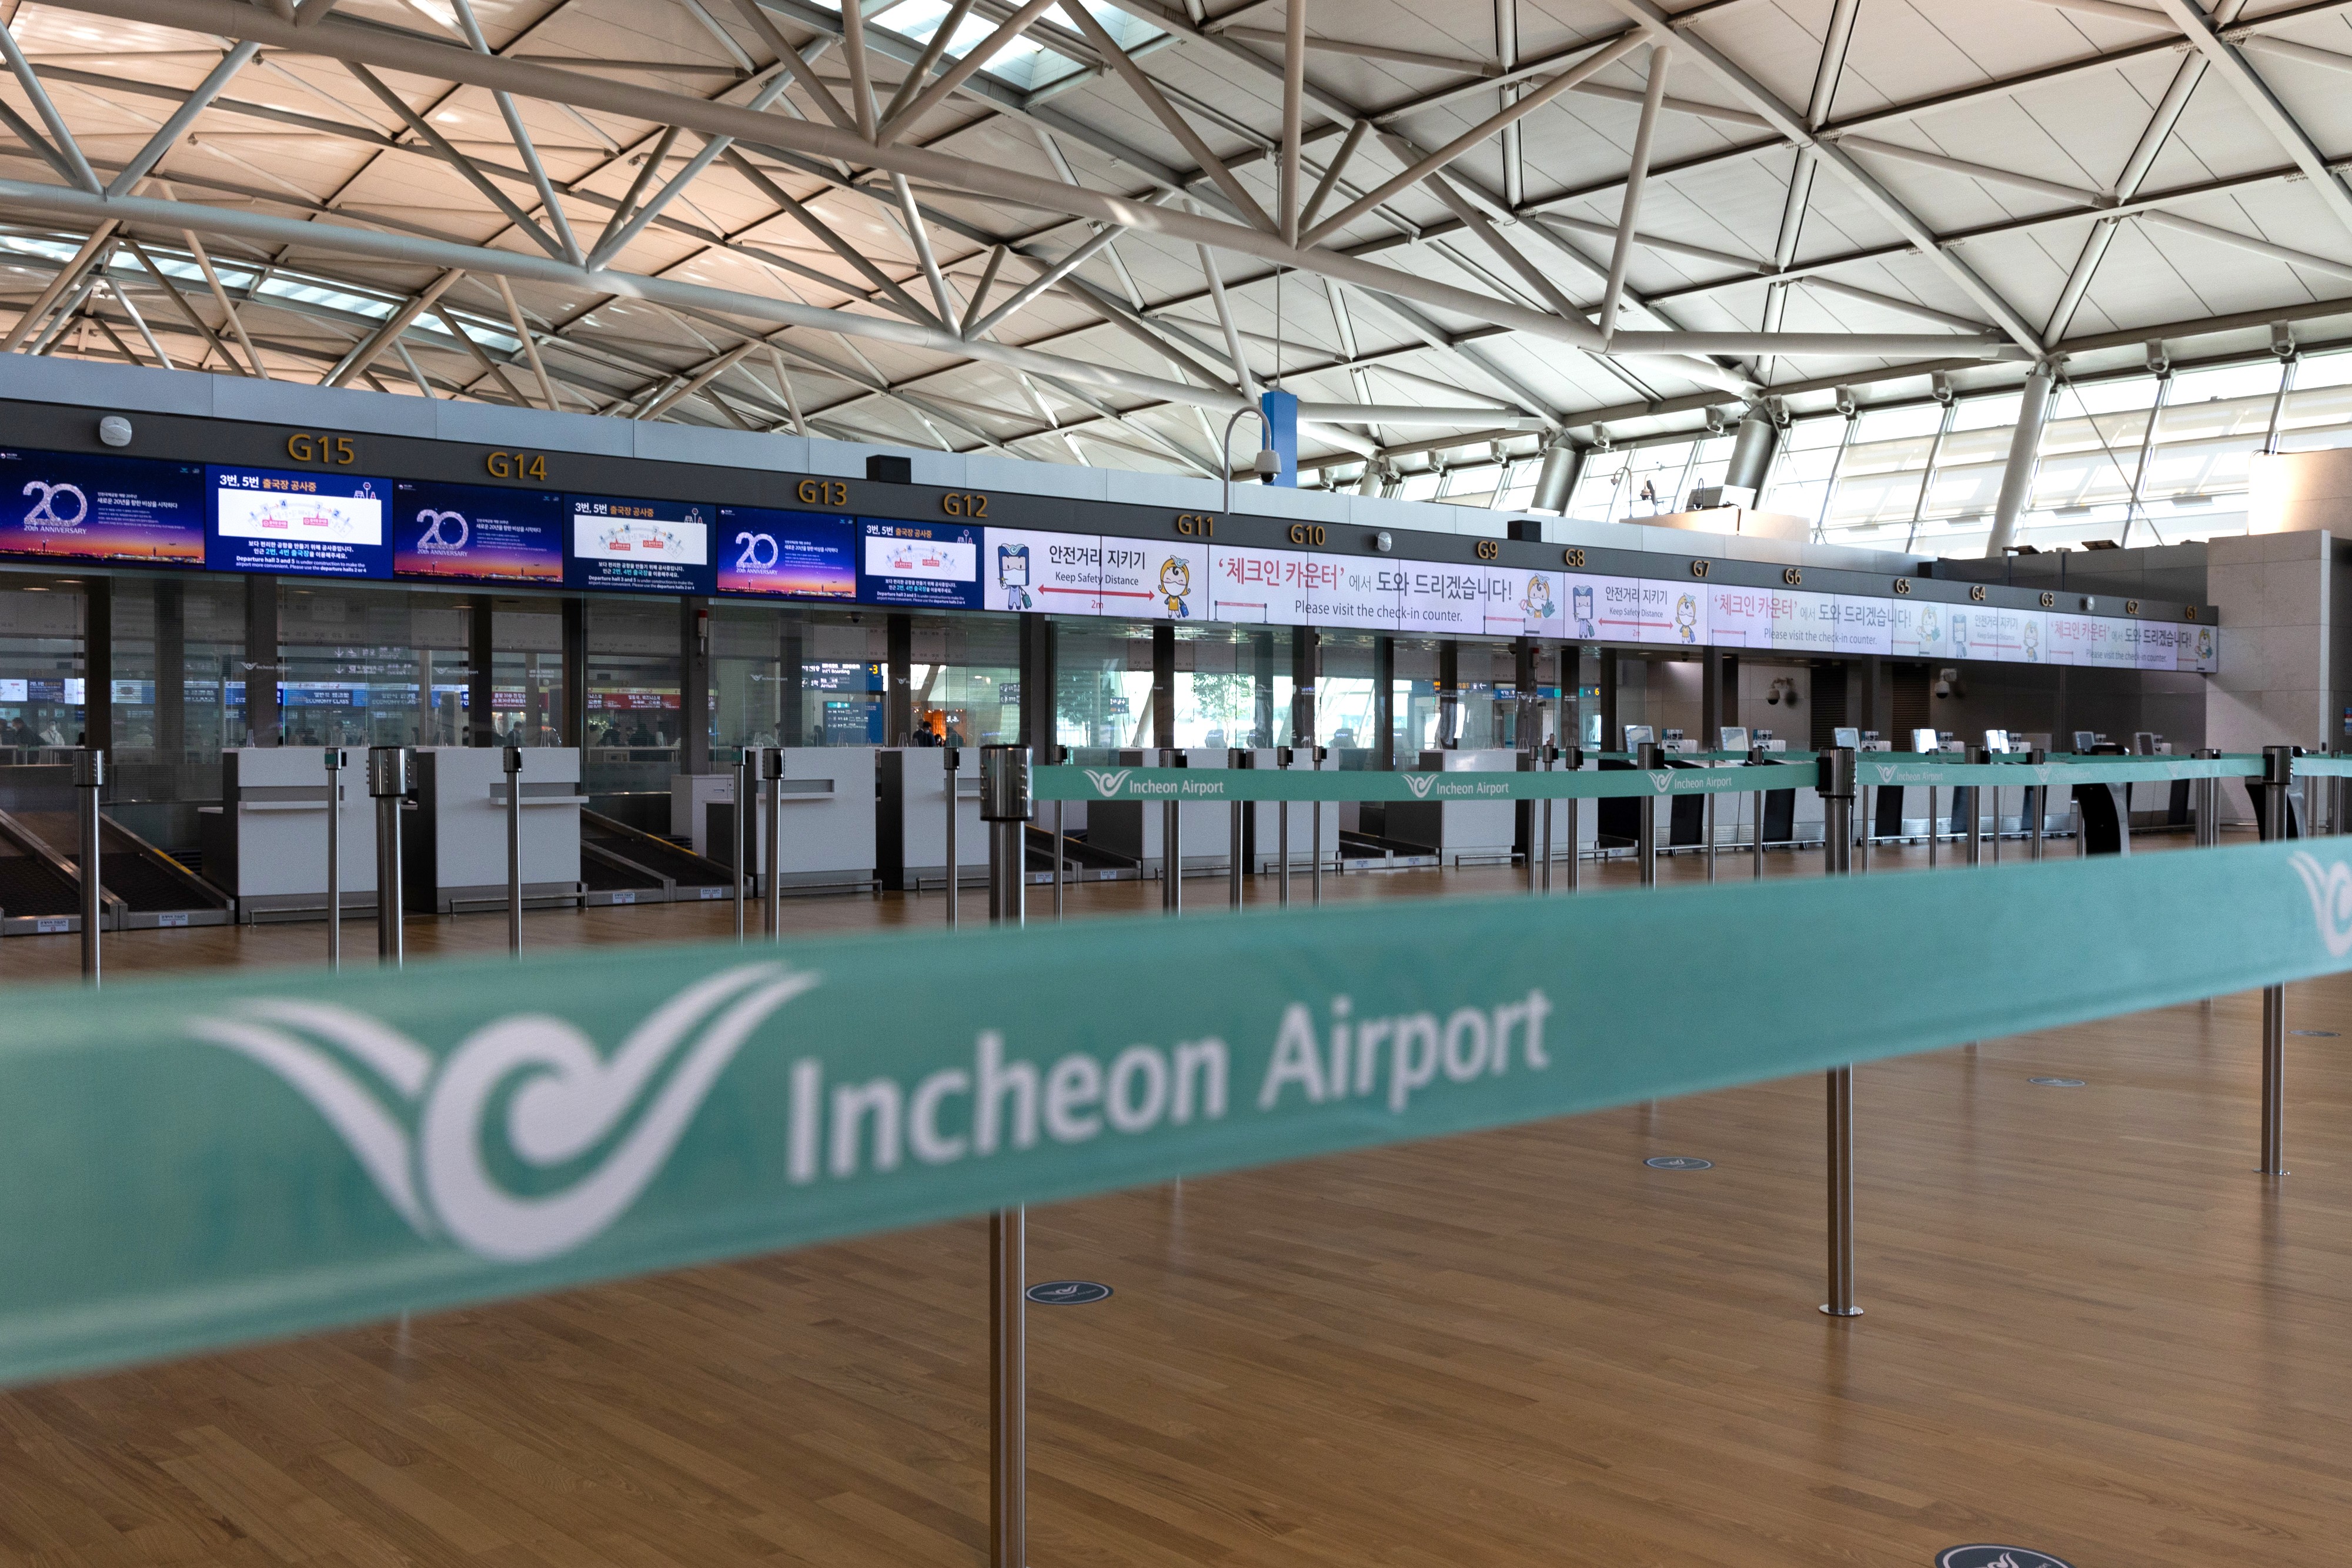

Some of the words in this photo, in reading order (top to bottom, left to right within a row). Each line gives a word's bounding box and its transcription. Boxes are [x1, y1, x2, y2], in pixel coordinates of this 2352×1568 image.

[288, 434, 355, 464] G15
[487, 452, 547, 481] G14
[220, 474, 240, 487] 3번,
[242, 476, 259, 488] 5번
[262, 478, 289, 490] 출국장
[291, 480, 317, 492] 공사중
[798, 480, 847, 506] G13
[23, 481, 88, 526] 20
[575, 503, 592, 513] 3번,
[593, 504, 607, 514] 5번
[610, 506, 632, 516] 출국장
[633, 507, 654, 517] 공사중
[944, 493, 988, 518] G12
[40, 526, 87, 534] ANNIVERSARY
[416, 509, 469, 550] 20
[867, 524, 880, 535] 3번,
[881, 526, 893, 536] 5번
[896, 527, 913, 537] 출국장
[914, 529, 932, 538] 공사중
[1178, 514, 1214, 537] G11
[1291, 524, 1326, 546] G10
[736, 531, 778, 569] 20
[1050, 546, 1101, 567] 안전거리
[1107, 550, 1145, 570] 지키기
[1478, 540, 1498, 560] G9
[1565, 548, 1585, 567] G8
[1693, 560, 1711, 577] G7
[1785, 568, 1802, 585] G6
[1055, 571, 1075, 583] Keep
[1078, 573, 1102, 585] Safety
[1105, 575, 1138, 586] Distance
[1349, 574, 1371, 592] 에서
[1377, 571, 1409, 596] 도와
[1414, 574, 1511, 602] 드리겠습니다!
[1896, 579, 1911, 595] G5
[1606, 587, 1639, 603] 안전거리
[1643, 589, 1667, 605] 지키기
[1972, 586, 1986, 601] G4
[2042, 592, 2054, 607] G3
[1091, 600, 1104, 609] 2m
[1295, 600, 1329, 614] Please
[1333, 602, 1354, 616] visit
[1357, 603, 1374, 617] the
[1377, 604, 1419, 618] check-in
[1423, 609, 1462, 621] counter.
[1609, 607, 1622, 617] Keep
[1624, 608, 1640, 618] Safety
[1642, 609, 1663, 618] Distance
[2127, 600, 2139, 614] G2
[2186, 605, 2197, 620] G1
[1800, 607, 1815, 621] 에서
[1819, 604, 1841, 624] 도와
[1844, 606, 1911, 628] 드리겠습니다!
[1765, 628, 1788, 639] Please
[1789, 630, 1803, 641] visit
[1805, 631, 1817, 641] the
[1819, 631, 1848, 643] check-in
[1850, 635, 1877, 645] counter.
[1674, 777, 1703, 789] Incheon
[1706, 777, 1732, 788] Airport
[1896, 771, 1921, 781] Incheon
[1922, 771, 1943, 782] Airport
[1130, 779, 1177, 793] Incheon
[1181, 780, 1224, 796] Airport
[1436, 782, 1474, 794] Incheon
[1476, 782, 1509, 796] Airport
[785, 1029, 1229, 1182] Incheon
[1257, 988, 1551, 1114] Airport
